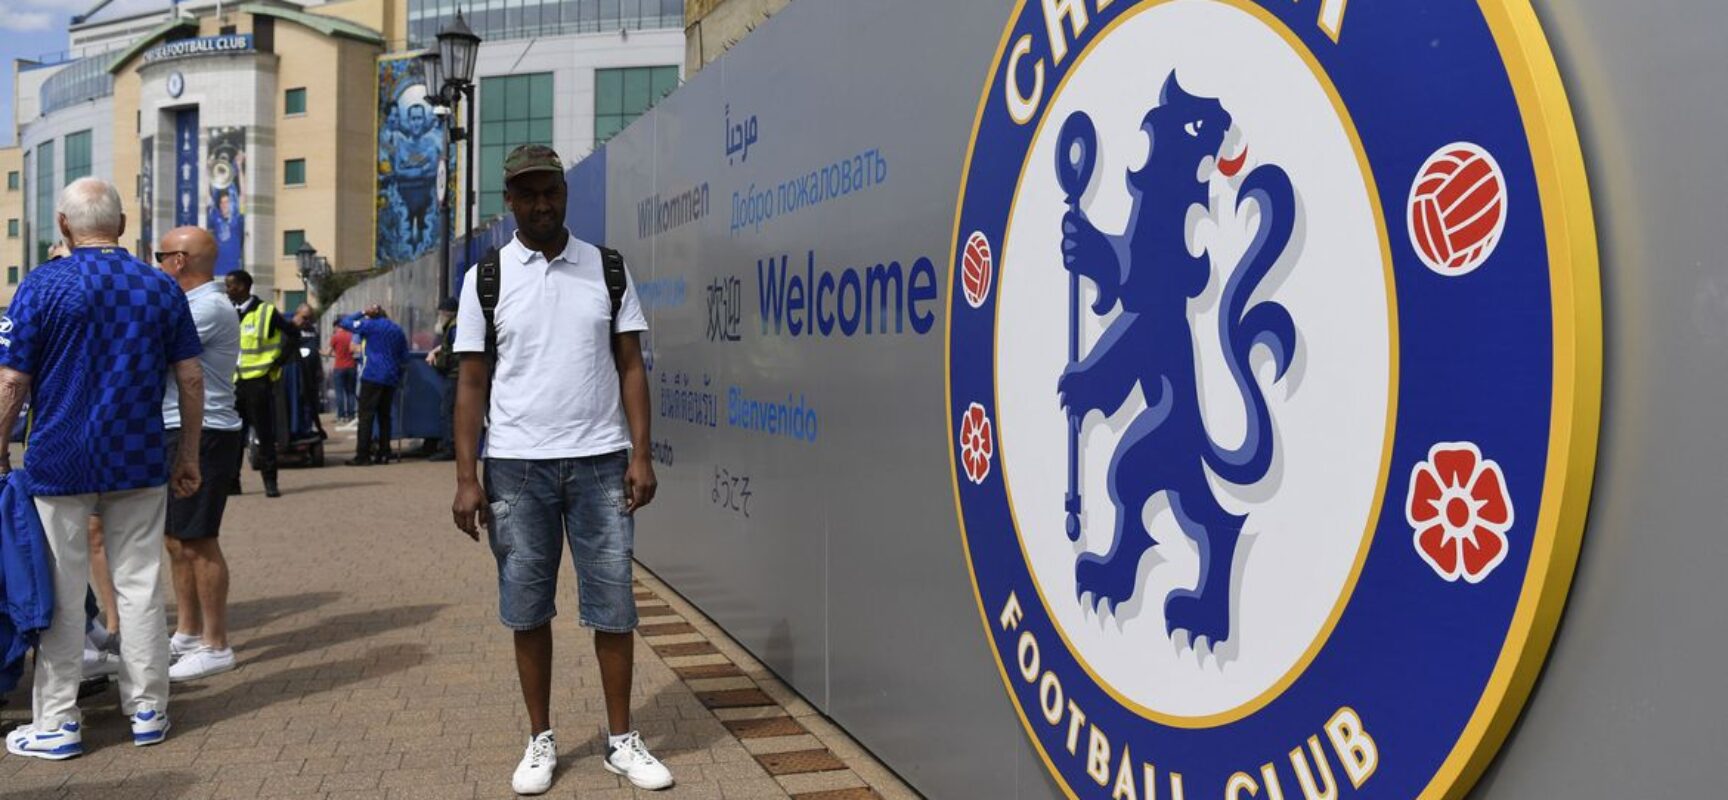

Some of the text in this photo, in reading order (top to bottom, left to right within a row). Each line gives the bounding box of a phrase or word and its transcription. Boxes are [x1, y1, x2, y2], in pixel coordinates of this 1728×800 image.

[168, 39, 214, 56] FOOTBALL
[217, 36, 247, 50] CLUB
[637, 181, 710, 240] Willkommen
[730, 149, 887, 237] Добро пожаловать
[706, 275, 742, 342] 欢迎
[757, 250, 938, 338] Welcome
[728, 385, 818, 443] Bienvenido
[649, 439, 674, 467] enuto
[711, 465, 752, 518] ようこそ
